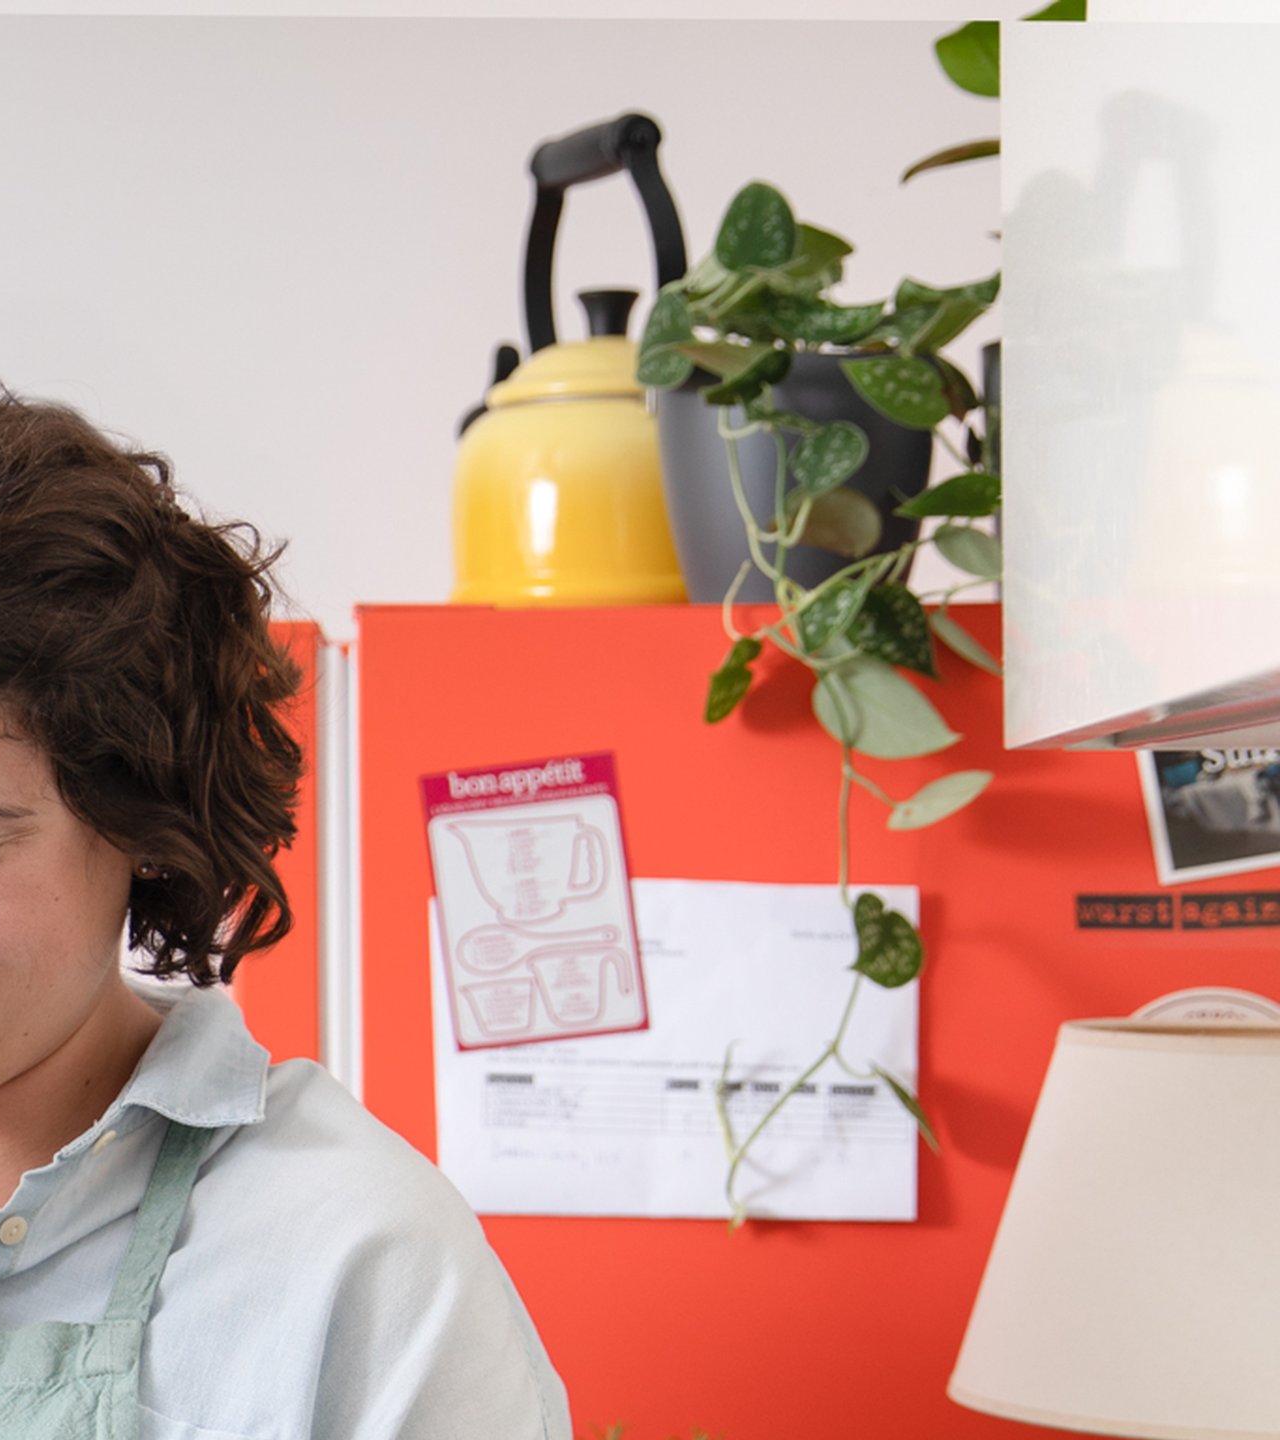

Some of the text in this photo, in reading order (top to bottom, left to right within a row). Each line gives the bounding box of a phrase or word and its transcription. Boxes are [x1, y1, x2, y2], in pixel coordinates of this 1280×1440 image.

[447, 770, 499, 800] bon
[498, 757, 587, 798] appétit
[1078, 899, 1172, 924] wurst
